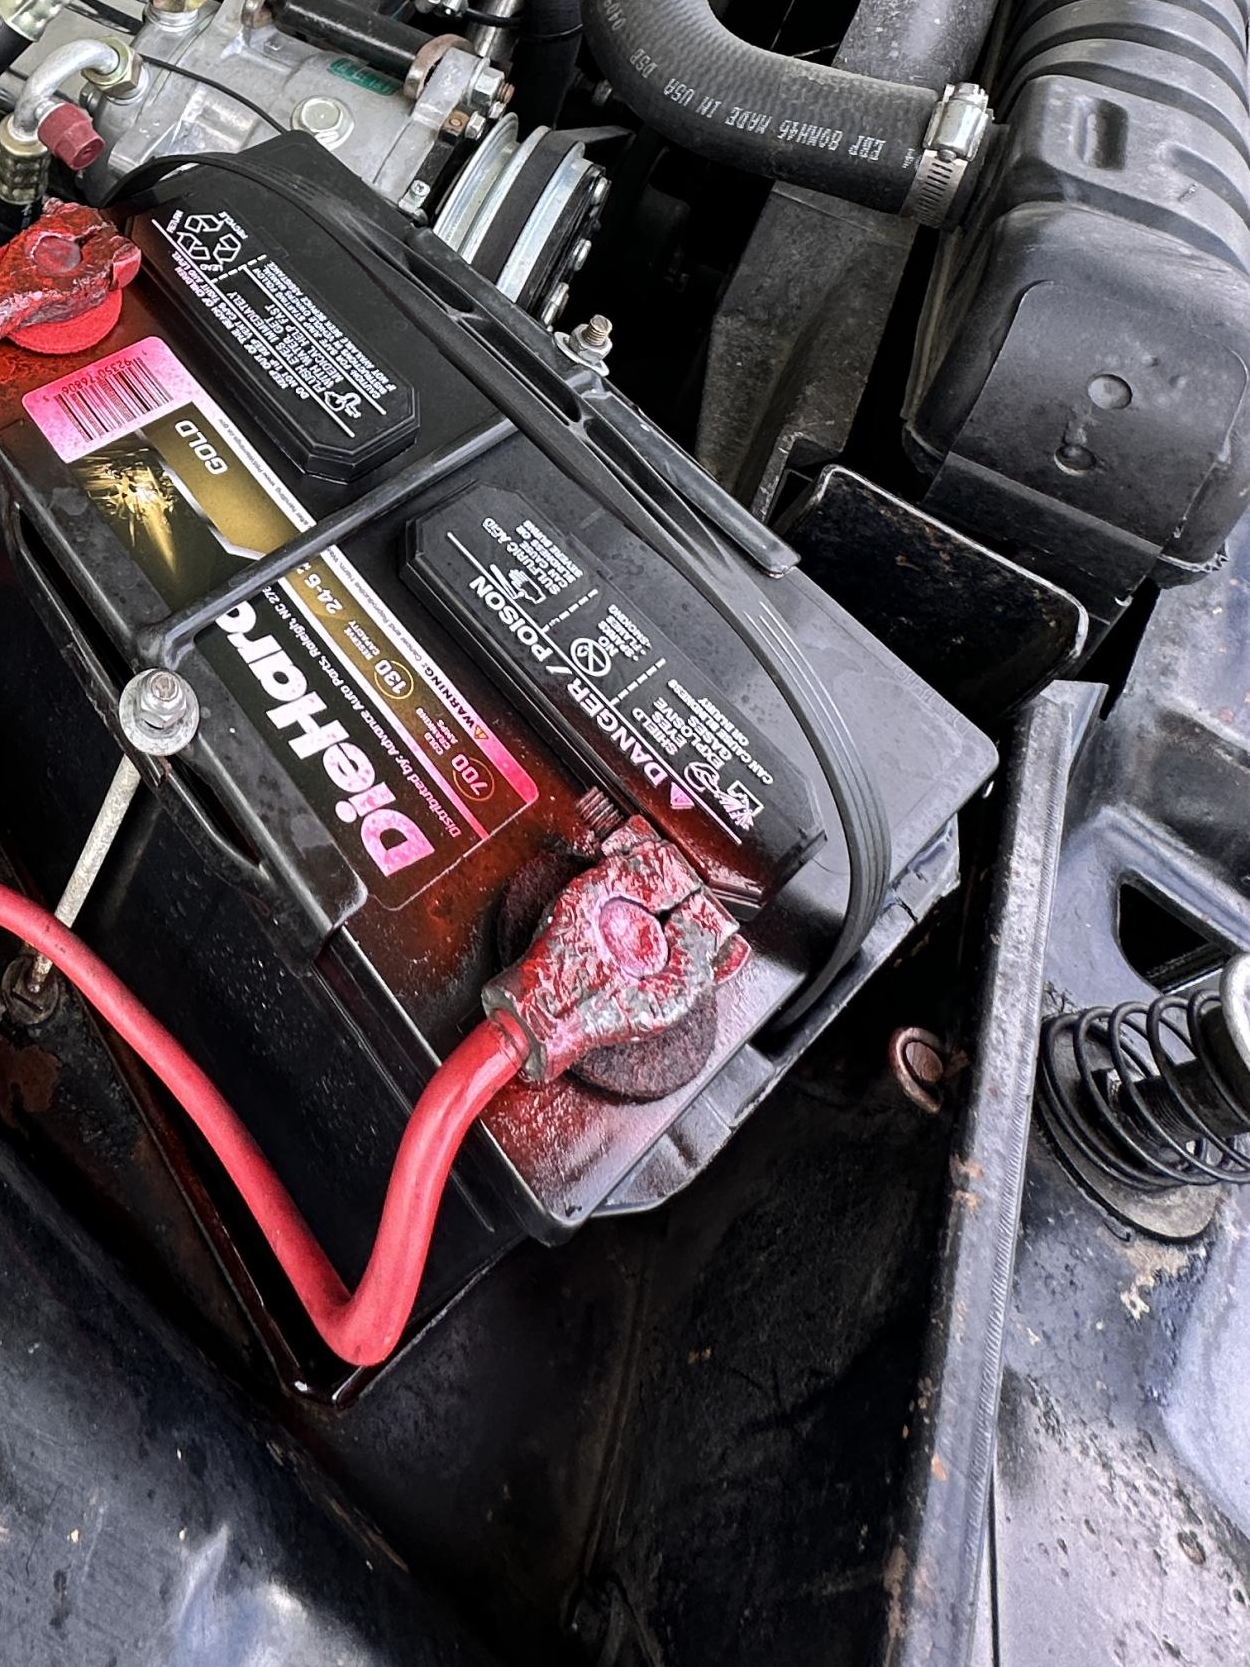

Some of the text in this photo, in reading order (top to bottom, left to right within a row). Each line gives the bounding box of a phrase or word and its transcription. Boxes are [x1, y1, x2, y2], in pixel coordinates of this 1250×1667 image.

[663, 78, 695, 105] USA
[696, 96, 721, 117] IN
[725, 106, 771, 133] MADE
[171, 251, 312, 399] DO NOT TIP KEEP VENT CAPS TIGHT AND LEVEL
[174, 266, 290, 388] KEEP OUT OF THE REACH OF CHILDREN
[227, 292, 327, 392] FLUSH EYES IMMEDIATELY
[264, 304, 343, 382] MEDICAL HELP FAST
[95, 356, 132, 379] 92350
[264, 316, 333, 388] WITH WATER. GET
[58, 372, 96, 396] 76806
[175, 420, 227, 474] GOLD
[482, 517, 560, 594] SULFURIC ACID
[515, 525, 575, 582] BLINDNESS OR
[519, 540, 567, 587] CAN CAUSE
[549, 545, 582, 577] SEVERE
[274, 603, 291, 619] NC
[304, 574, 342, 613] 24-6
[289, 618, 320, 657] Raleigh,
[348, 620, 379, 655] CAPACITY
[598, 620, 634, 656] SPARKS
[606, 615, 641, 651] FLAMES
[608, 604, 648, 644] SMOKING
[343, 627, 372, 660] RESERVE
[598, 636, 618, 656] NO
[318, 655, 343, 686] Parts,
[374, 659, 405, 693] 130
[470, 576, 666, 784] DANGER / POISON
[340, 685, 364, 709] Auto
[360, 710, 398, 754] Advance
[424, 732, 443, 755] COLD
[436, 719, 458, 743] AMPS
[632, 708, 677, 754] SHIELD
[652, 711, 686, 747] EYES
[654, 697, 724, 768] EXPLOSIVE
[668, 679, 773, 783] CAN CAUSE BLINDNESS
[687, 715, 731, 760] GASES
[731, 728, 749, 746] OR
[395, 755, 412, 774] by:
[451, 754, 487, 795] 700
[407, 773, 460, 836] Distributed
